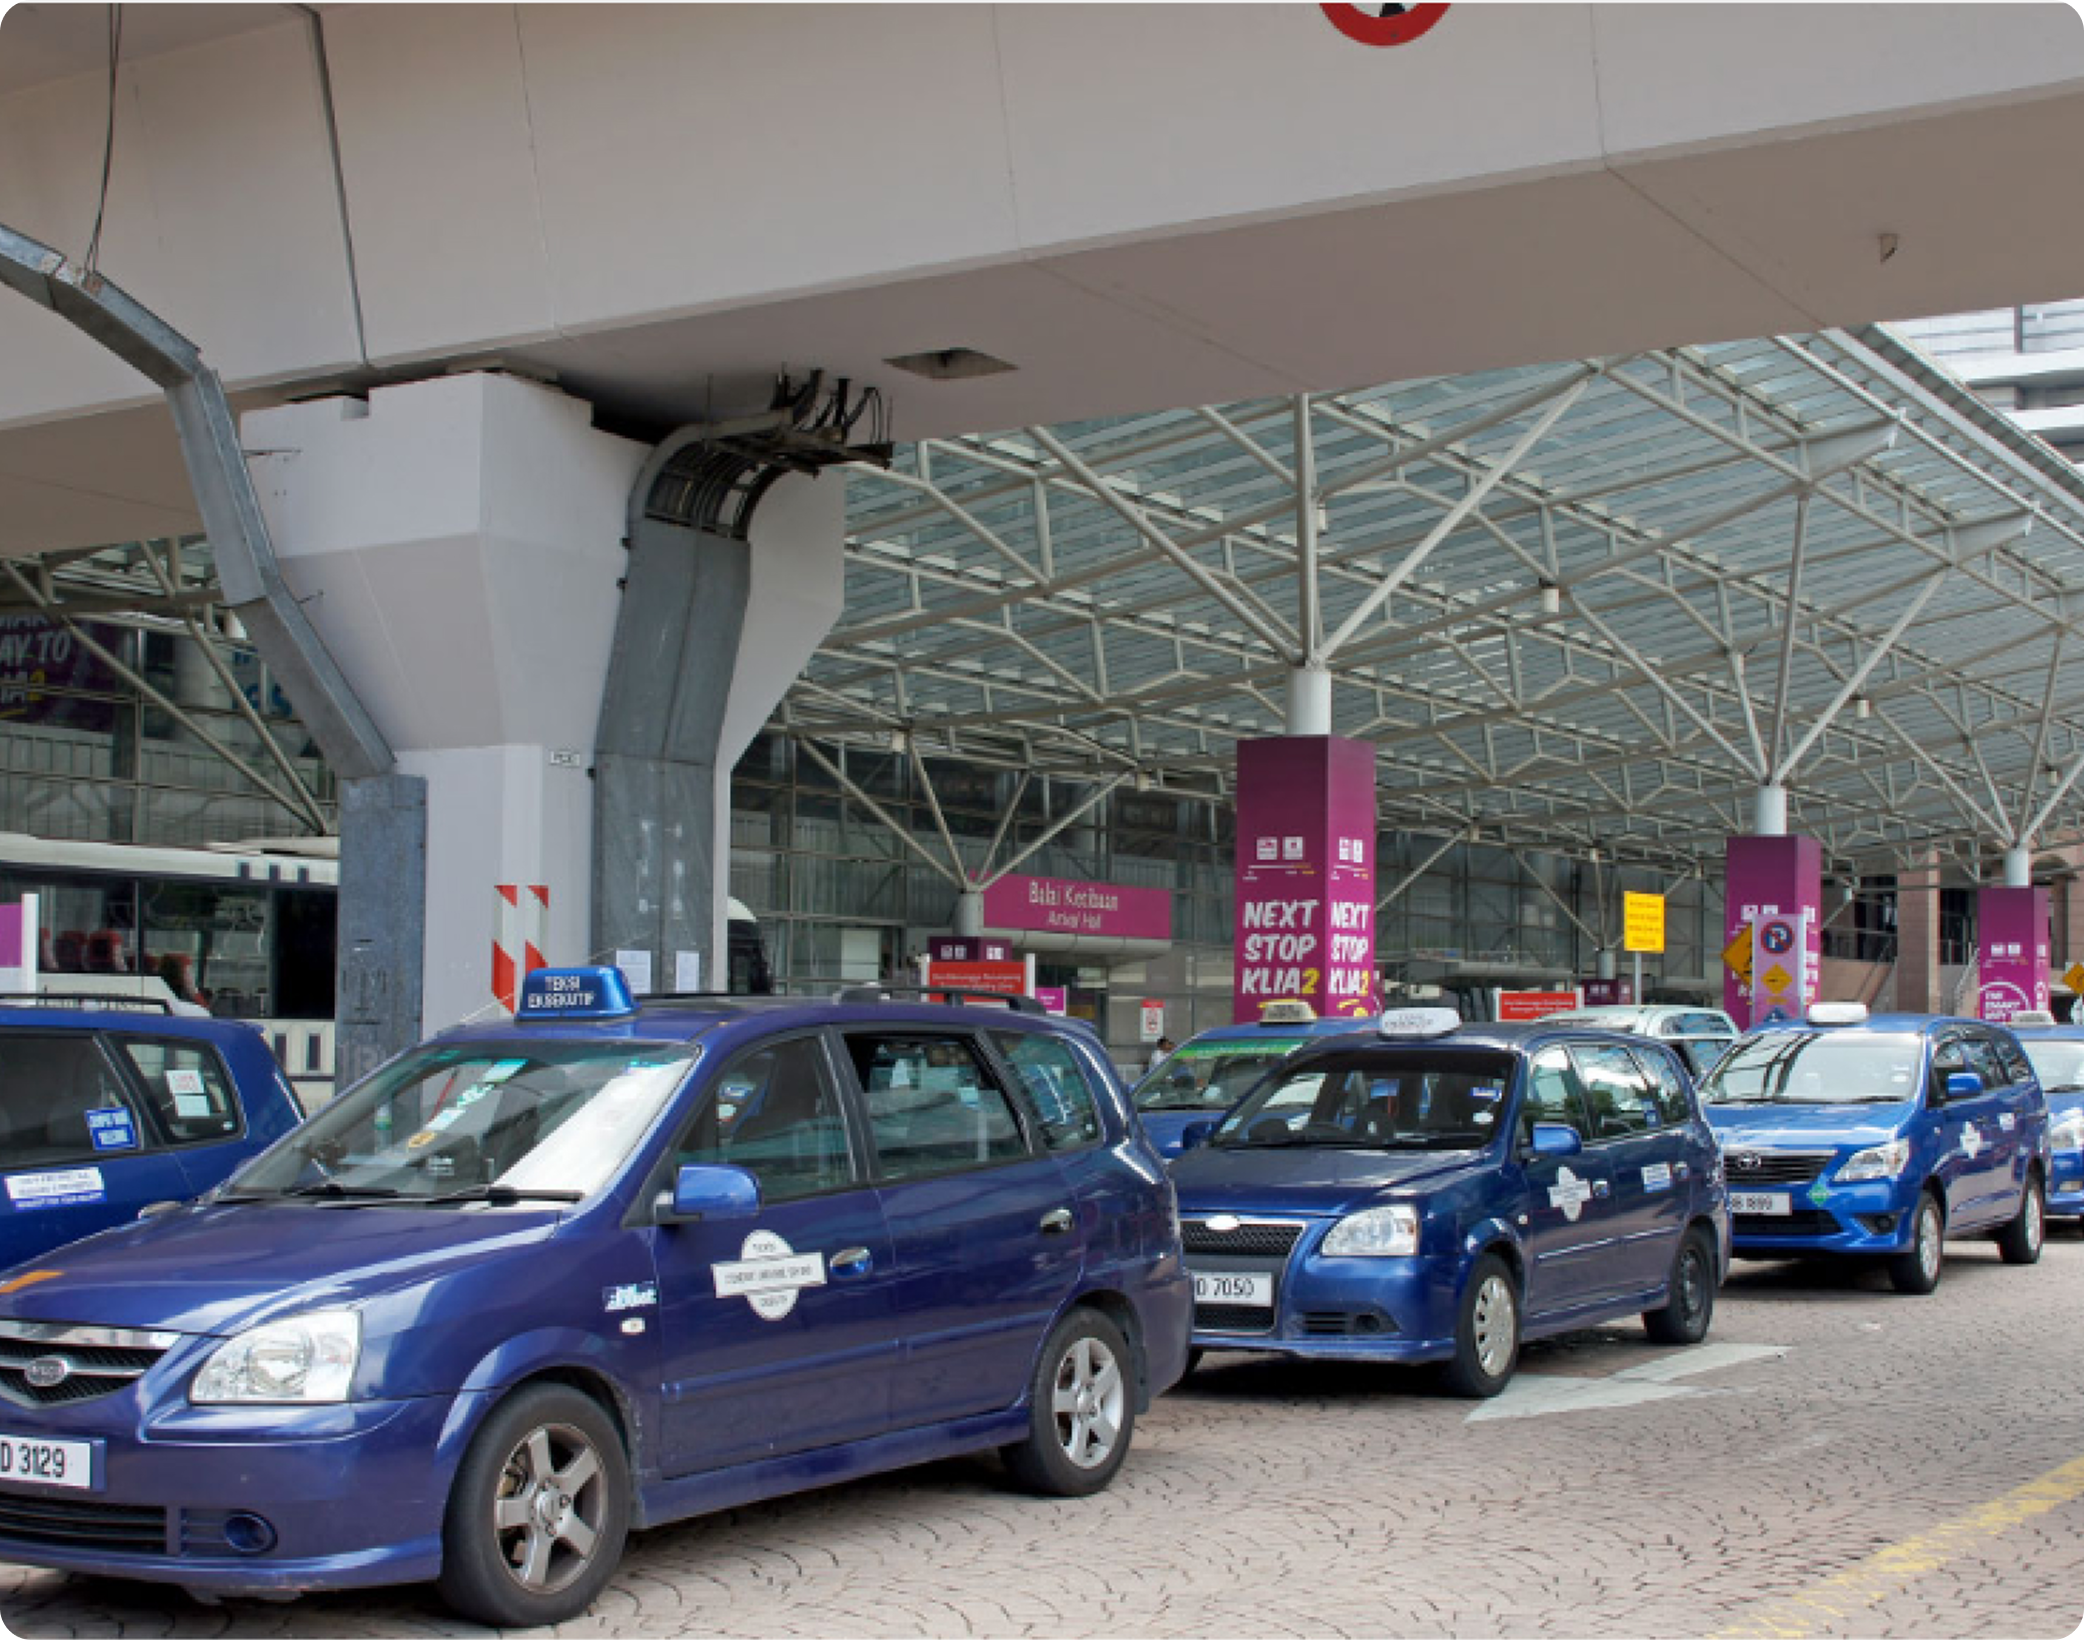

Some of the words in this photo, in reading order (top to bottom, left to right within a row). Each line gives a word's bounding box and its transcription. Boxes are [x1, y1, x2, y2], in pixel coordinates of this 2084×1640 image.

[38, 629, 72, 664] TO
[1029, 880, 1061, 906] Balai
[1243, 899, 1320, 929] NEXT
[1331, 901, 1370, 931] NEXT
[1244, 933, 1317, 963] STOP
[1331, 935, 1369, 963] STOP
[545, 975, 580, 991] TEKSI
[1242, 967, 1321, 995] KLIA2
[1328, 967, 1371, 996] KLIA2
[1213, 1277, 1255, 1297] 7050
[18, 1444, 66, 1478] 3129
